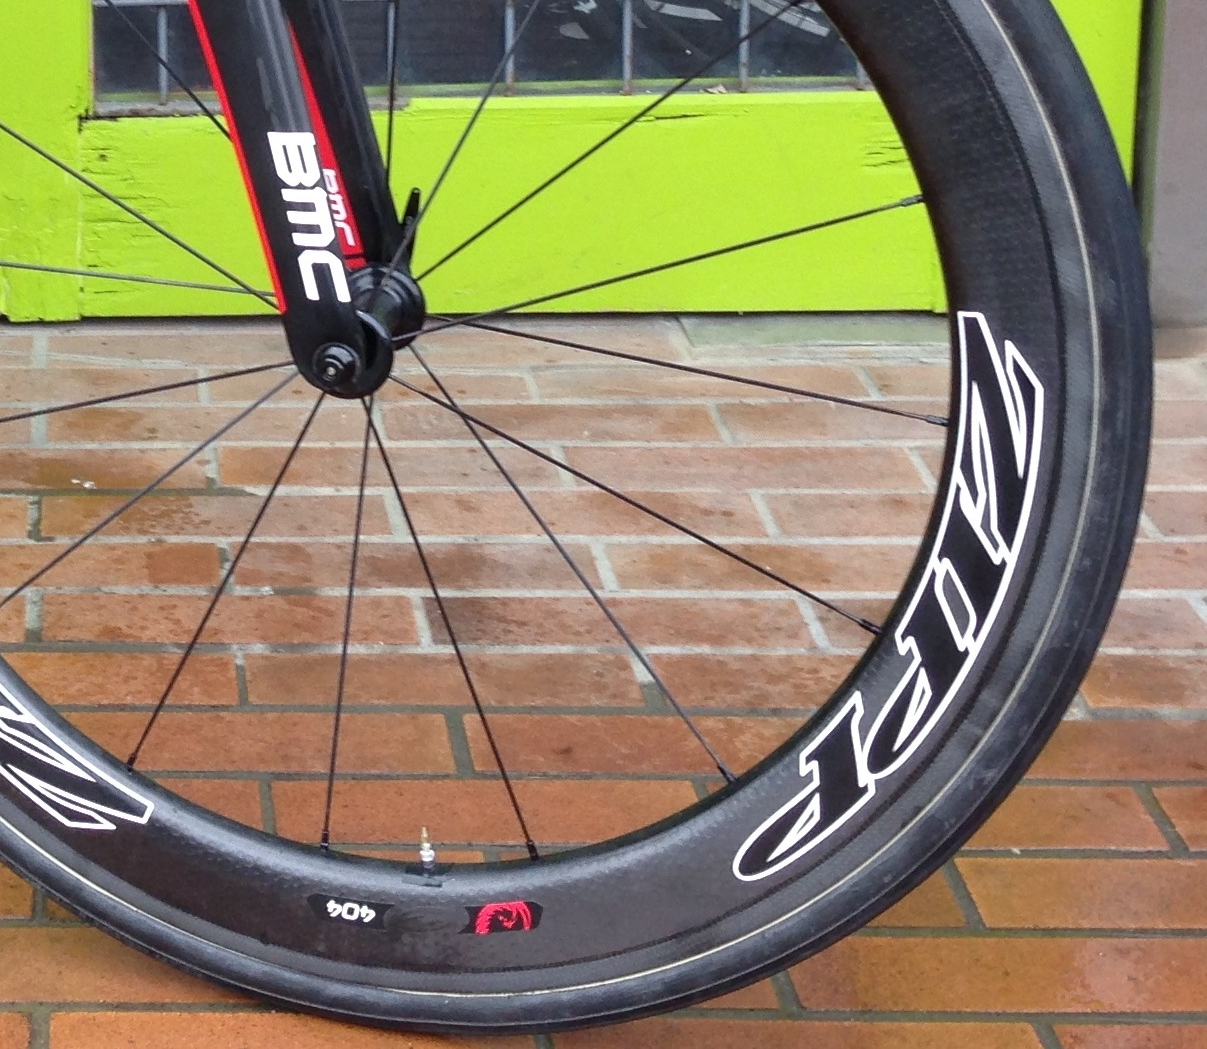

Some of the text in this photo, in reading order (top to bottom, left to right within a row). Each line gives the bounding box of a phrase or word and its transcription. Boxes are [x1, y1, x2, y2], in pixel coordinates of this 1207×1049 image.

[267, 131, 352, 302] BMC
[732, 311, 1045, 881] ZIPP
[325, 898, 376, 924] 404
